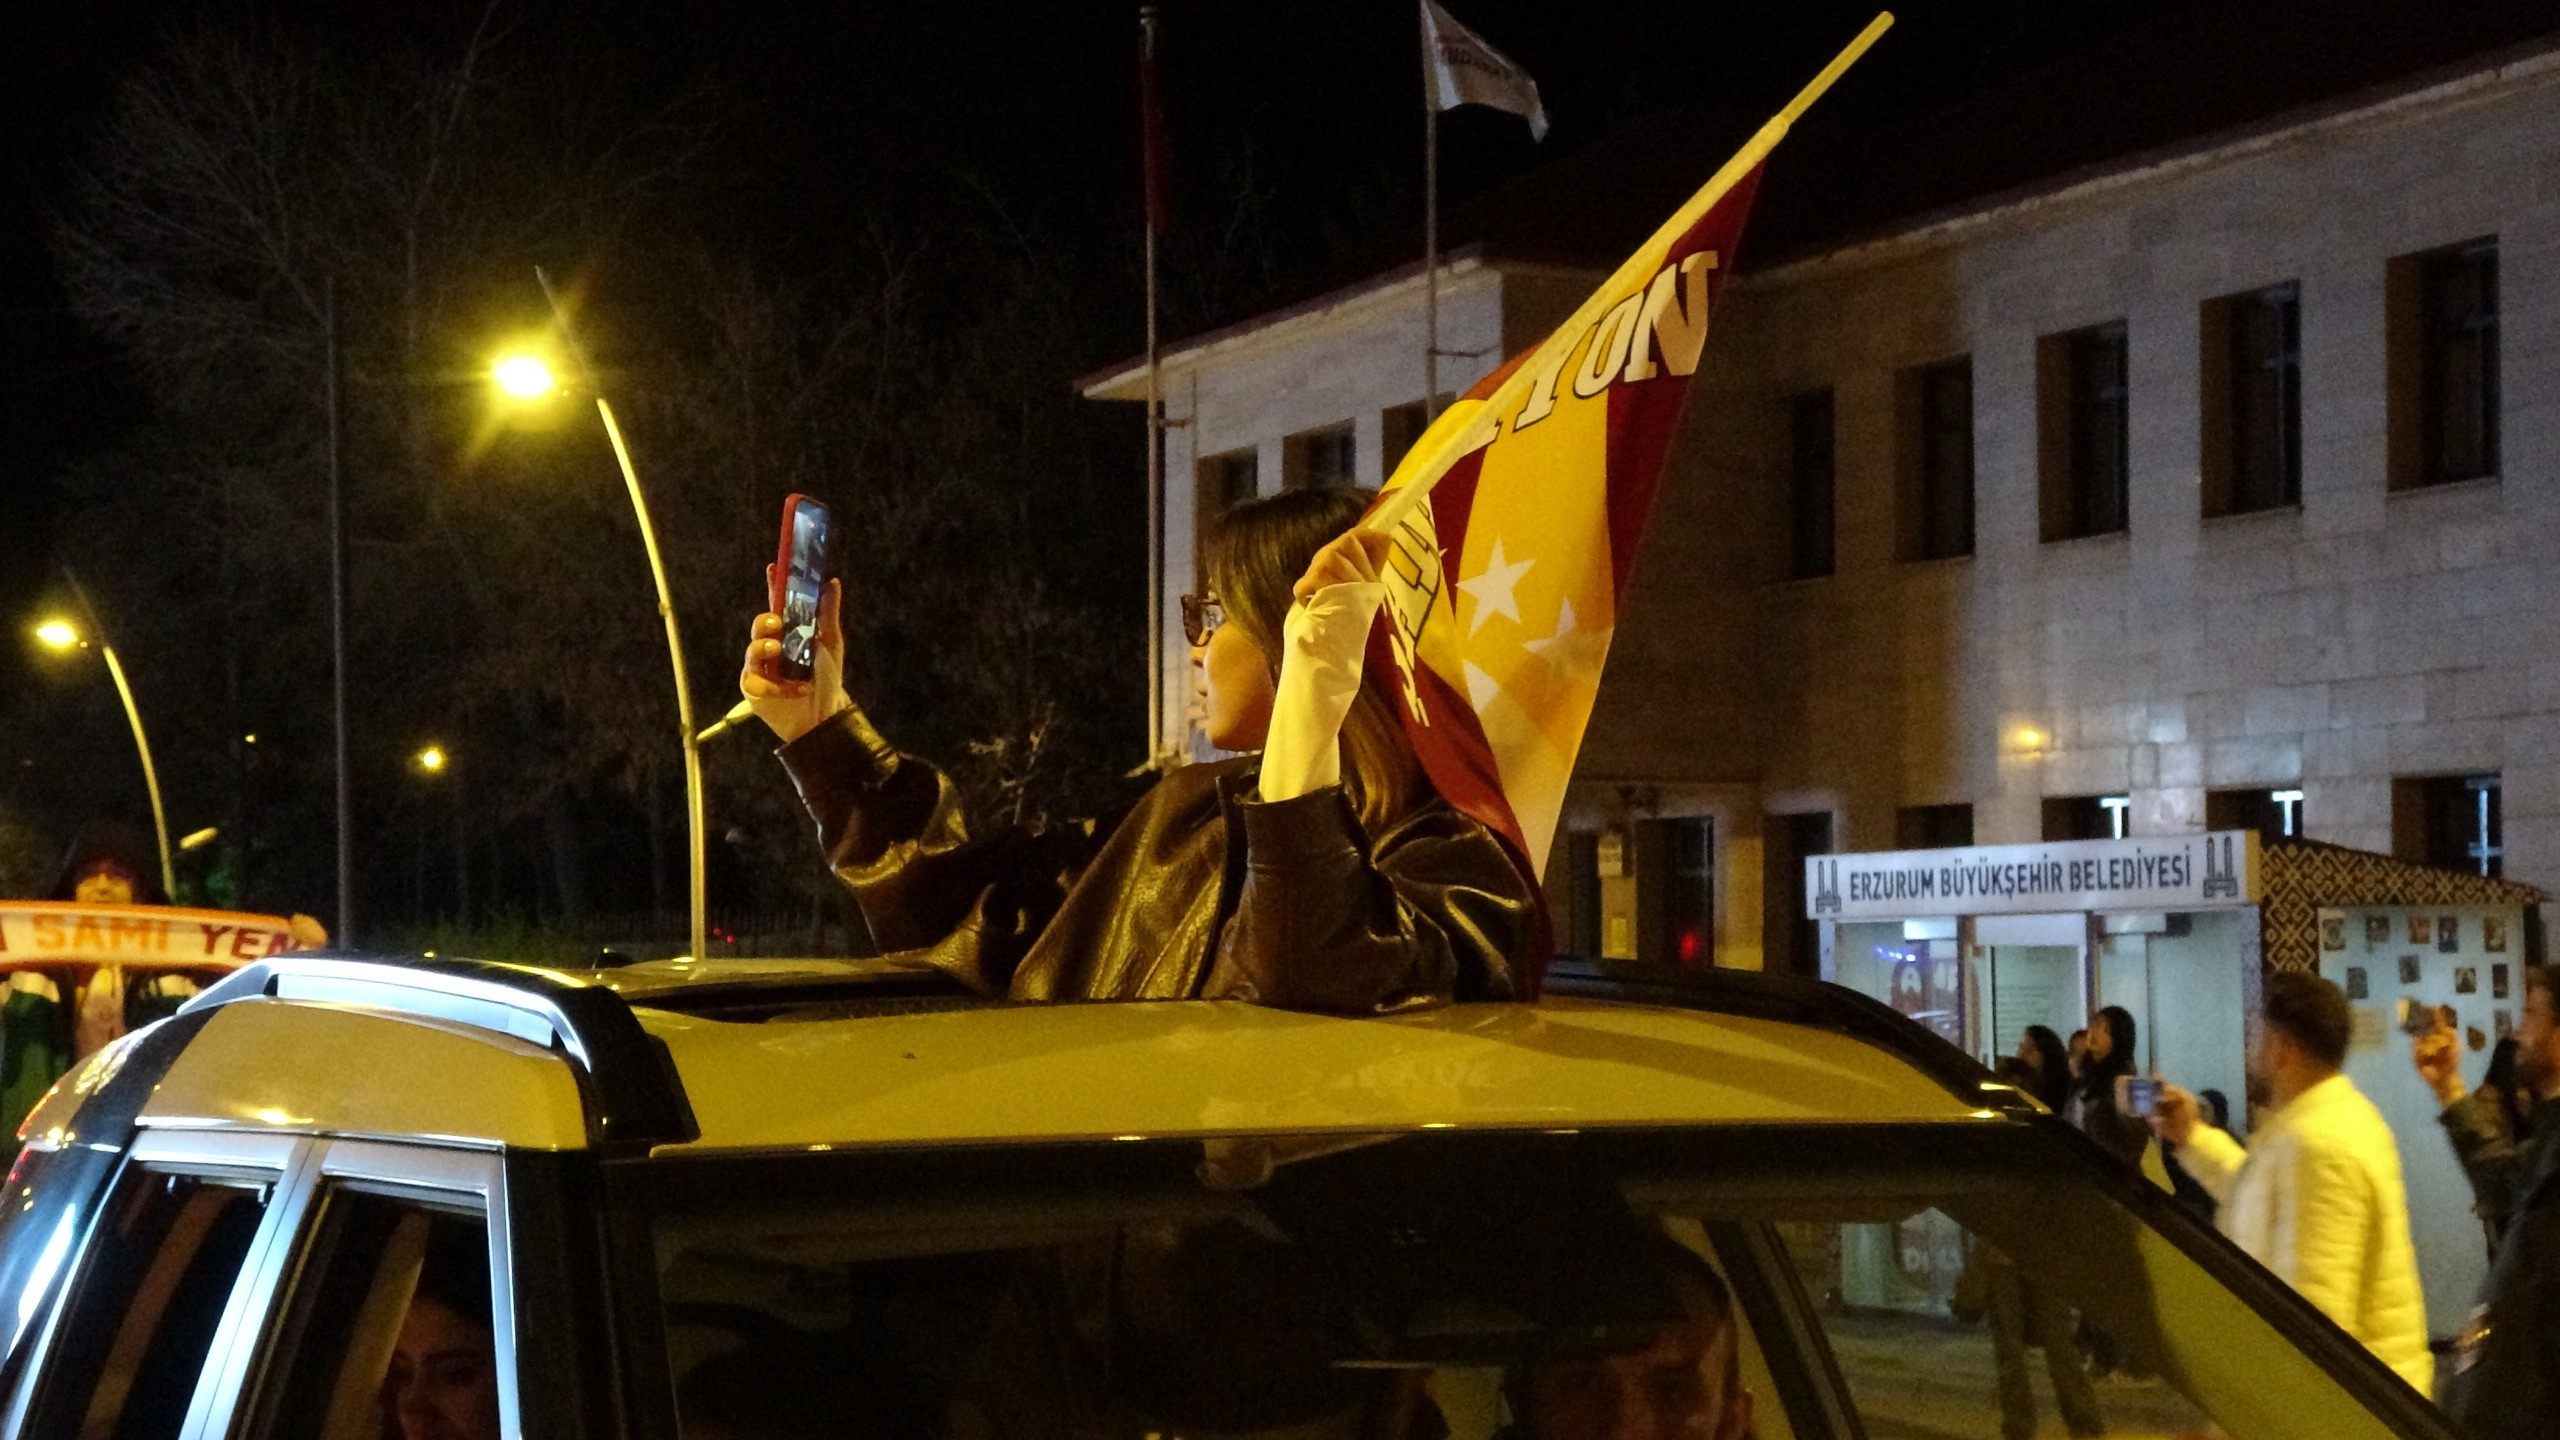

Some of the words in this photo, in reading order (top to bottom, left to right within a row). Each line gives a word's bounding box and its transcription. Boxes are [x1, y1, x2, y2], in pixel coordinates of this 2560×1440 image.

[1850, 868, 1935, 901] ERZURUM
[1940, 853, 2063, 899] BÜYÜKŞEHİR
[2069, 845, 2191, 892] BELEDİYESİ
